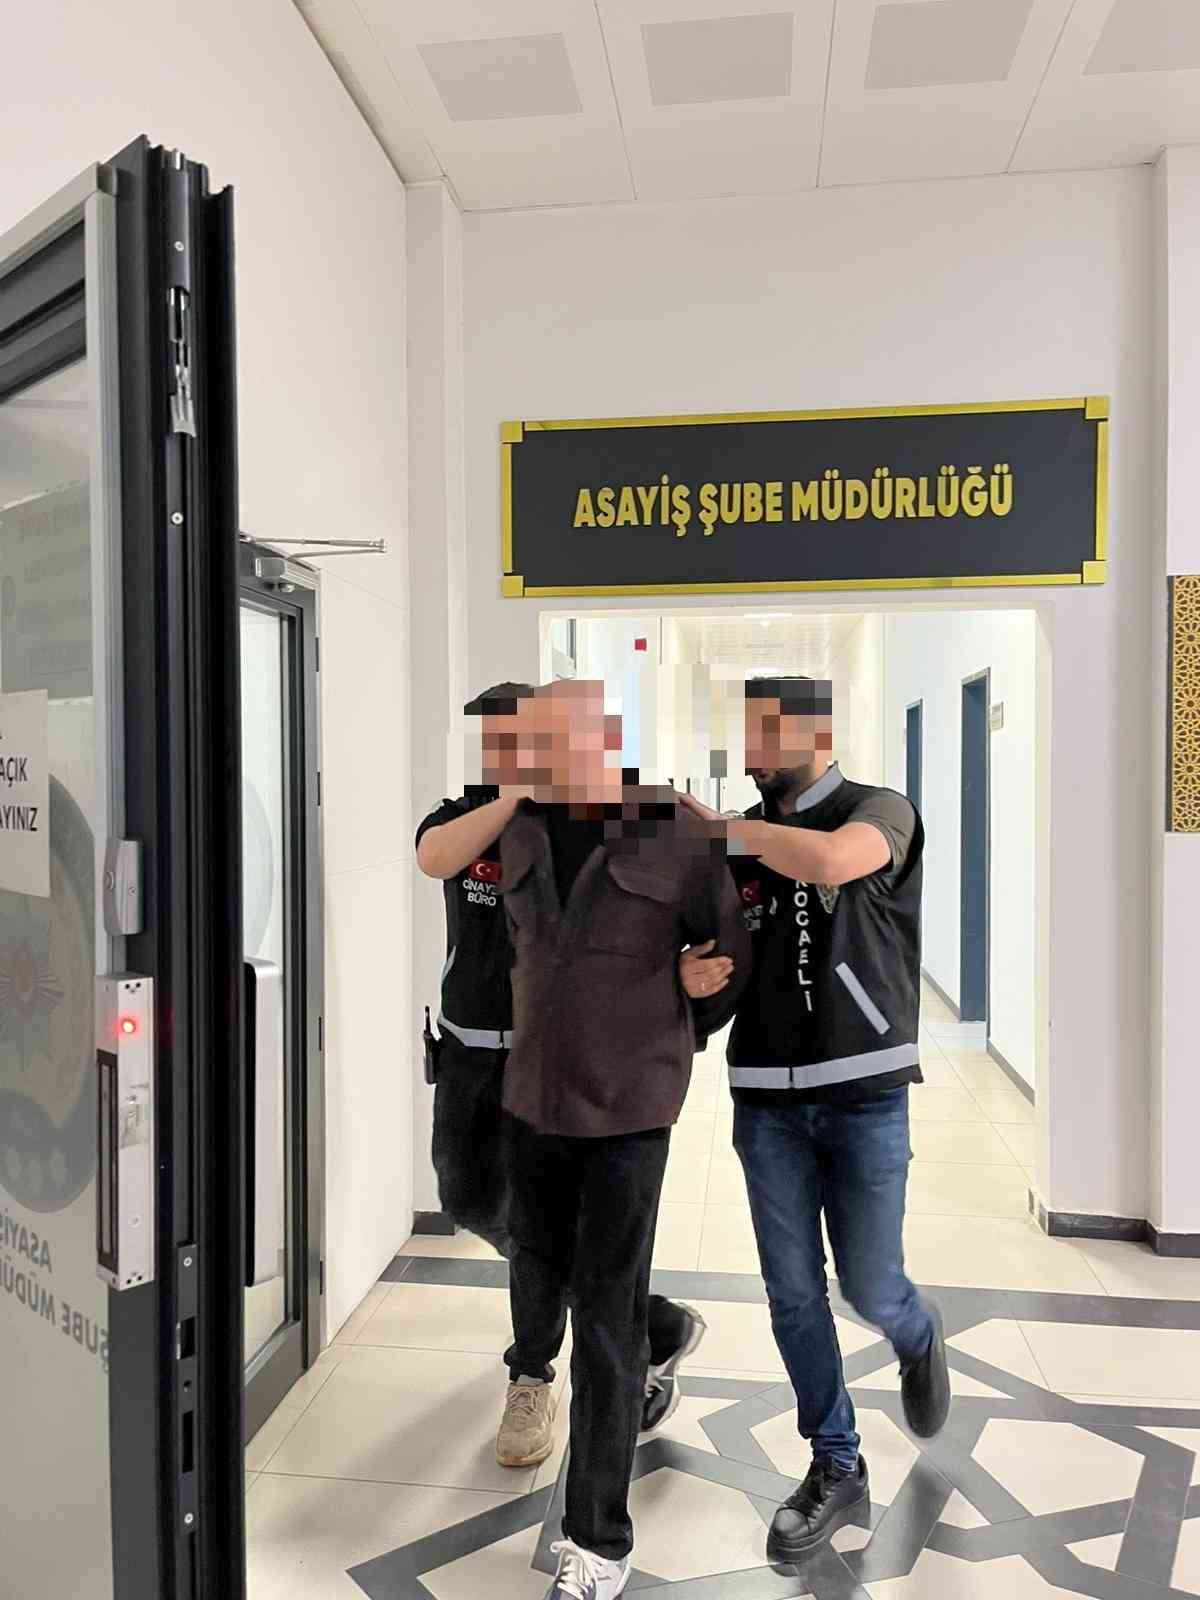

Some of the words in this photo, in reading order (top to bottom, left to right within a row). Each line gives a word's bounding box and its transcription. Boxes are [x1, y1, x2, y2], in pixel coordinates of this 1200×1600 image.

[573, 474, 691, 537] ASAYİŞ
[698, 480, 785, 536] ŞUBE
[791, 463, 1014, 522] MÜDÜRLÜĞÜ
[467, 891, 497, 907] BÜRO
